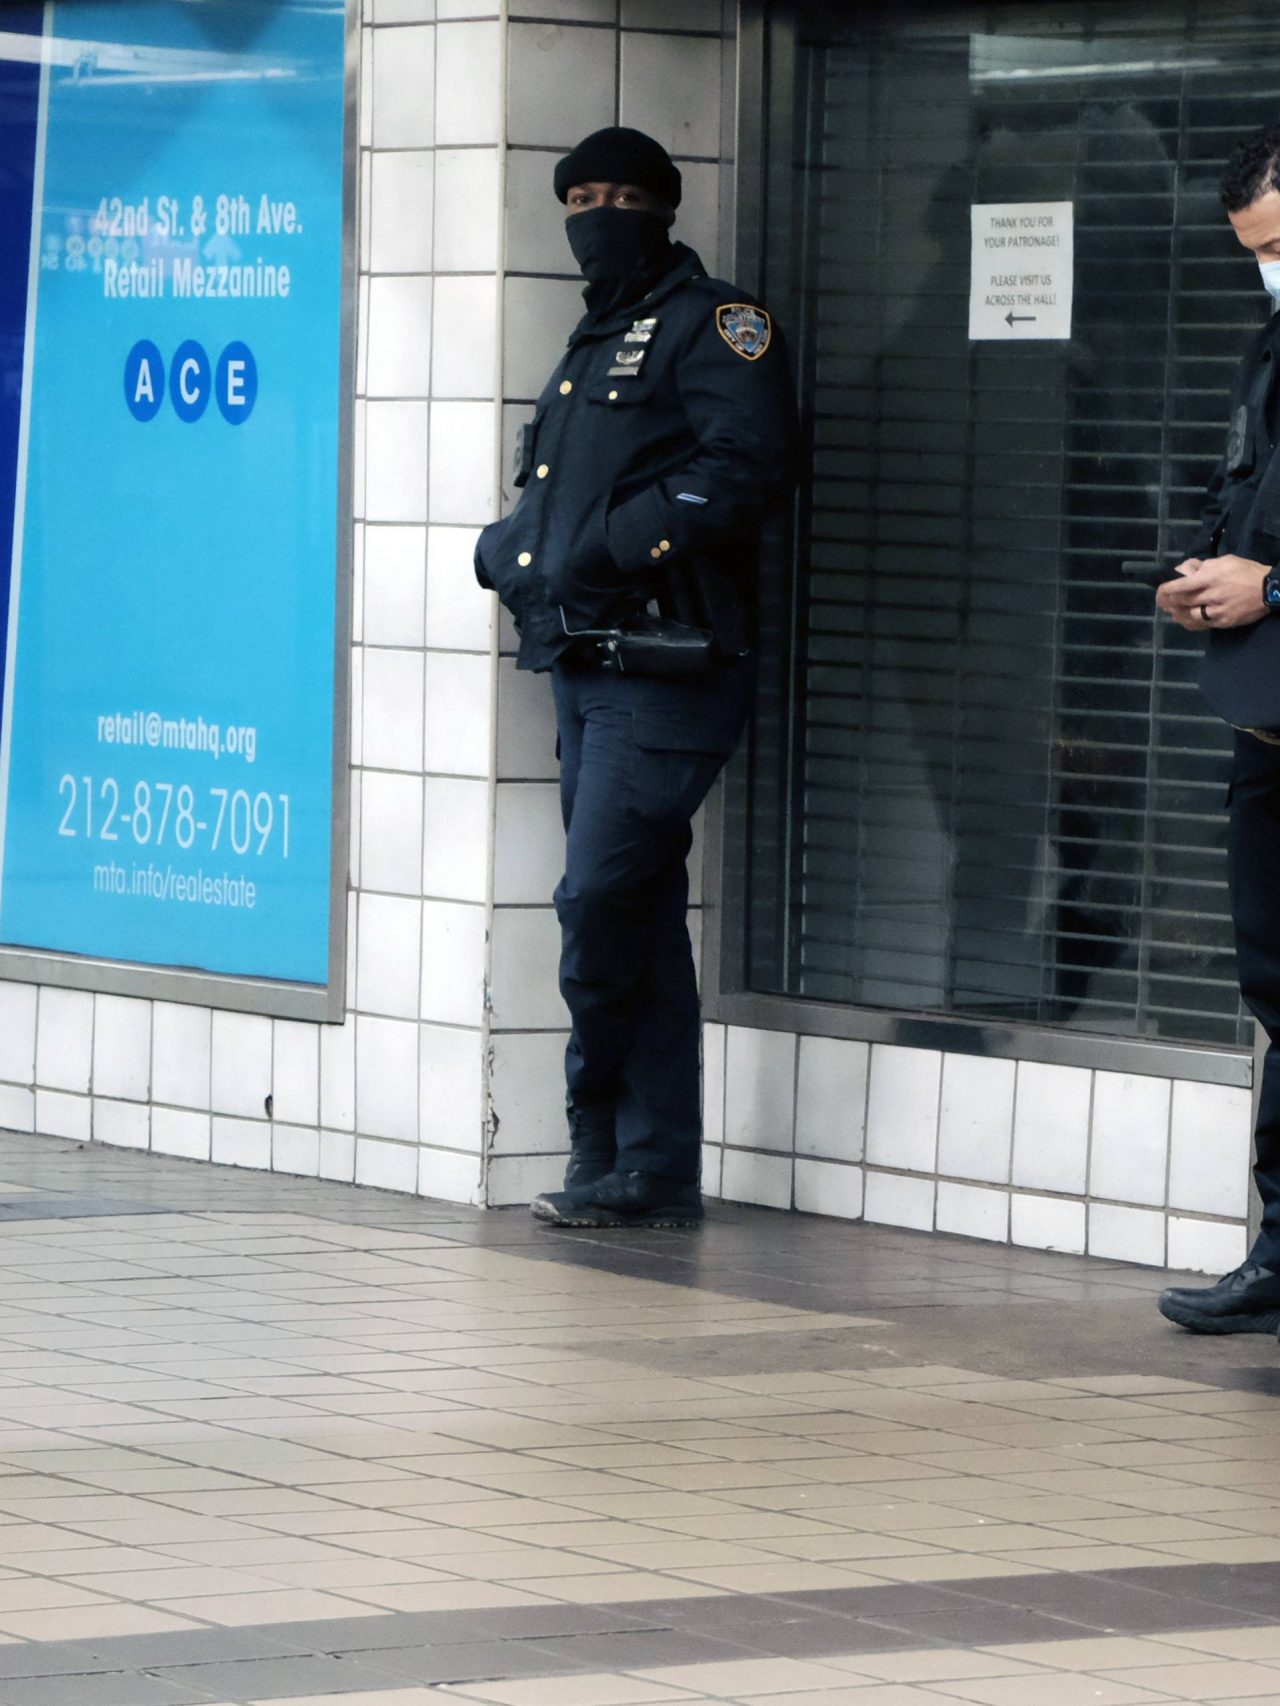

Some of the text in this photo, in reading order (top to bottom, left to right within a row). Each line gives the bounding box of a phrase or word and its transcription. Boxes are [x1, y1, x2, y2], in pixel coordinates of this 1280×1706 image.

[97, 194, 303, 236] 42nd St. & 8th Ave.
[991, 216, 1053, 229] THANK YOU FOR
[984, 234, 1059, 248] YOUR PATRONAGE!
[104, 257, 164, 299] Retail
[173, 257, 291, 299] Mezzanine
[990, 274, 1052, 287] PLEASE VISIT US
[985, 293, 1056, 306] ACROSS THE HALL!
[134, 358, 246, 405] A C E
[98, 711, 257, 763] retail@mtahq.org
[58, 773, 289, 858] 212-878-7091
[94, 862, 256, 909] mta.info/realestate
